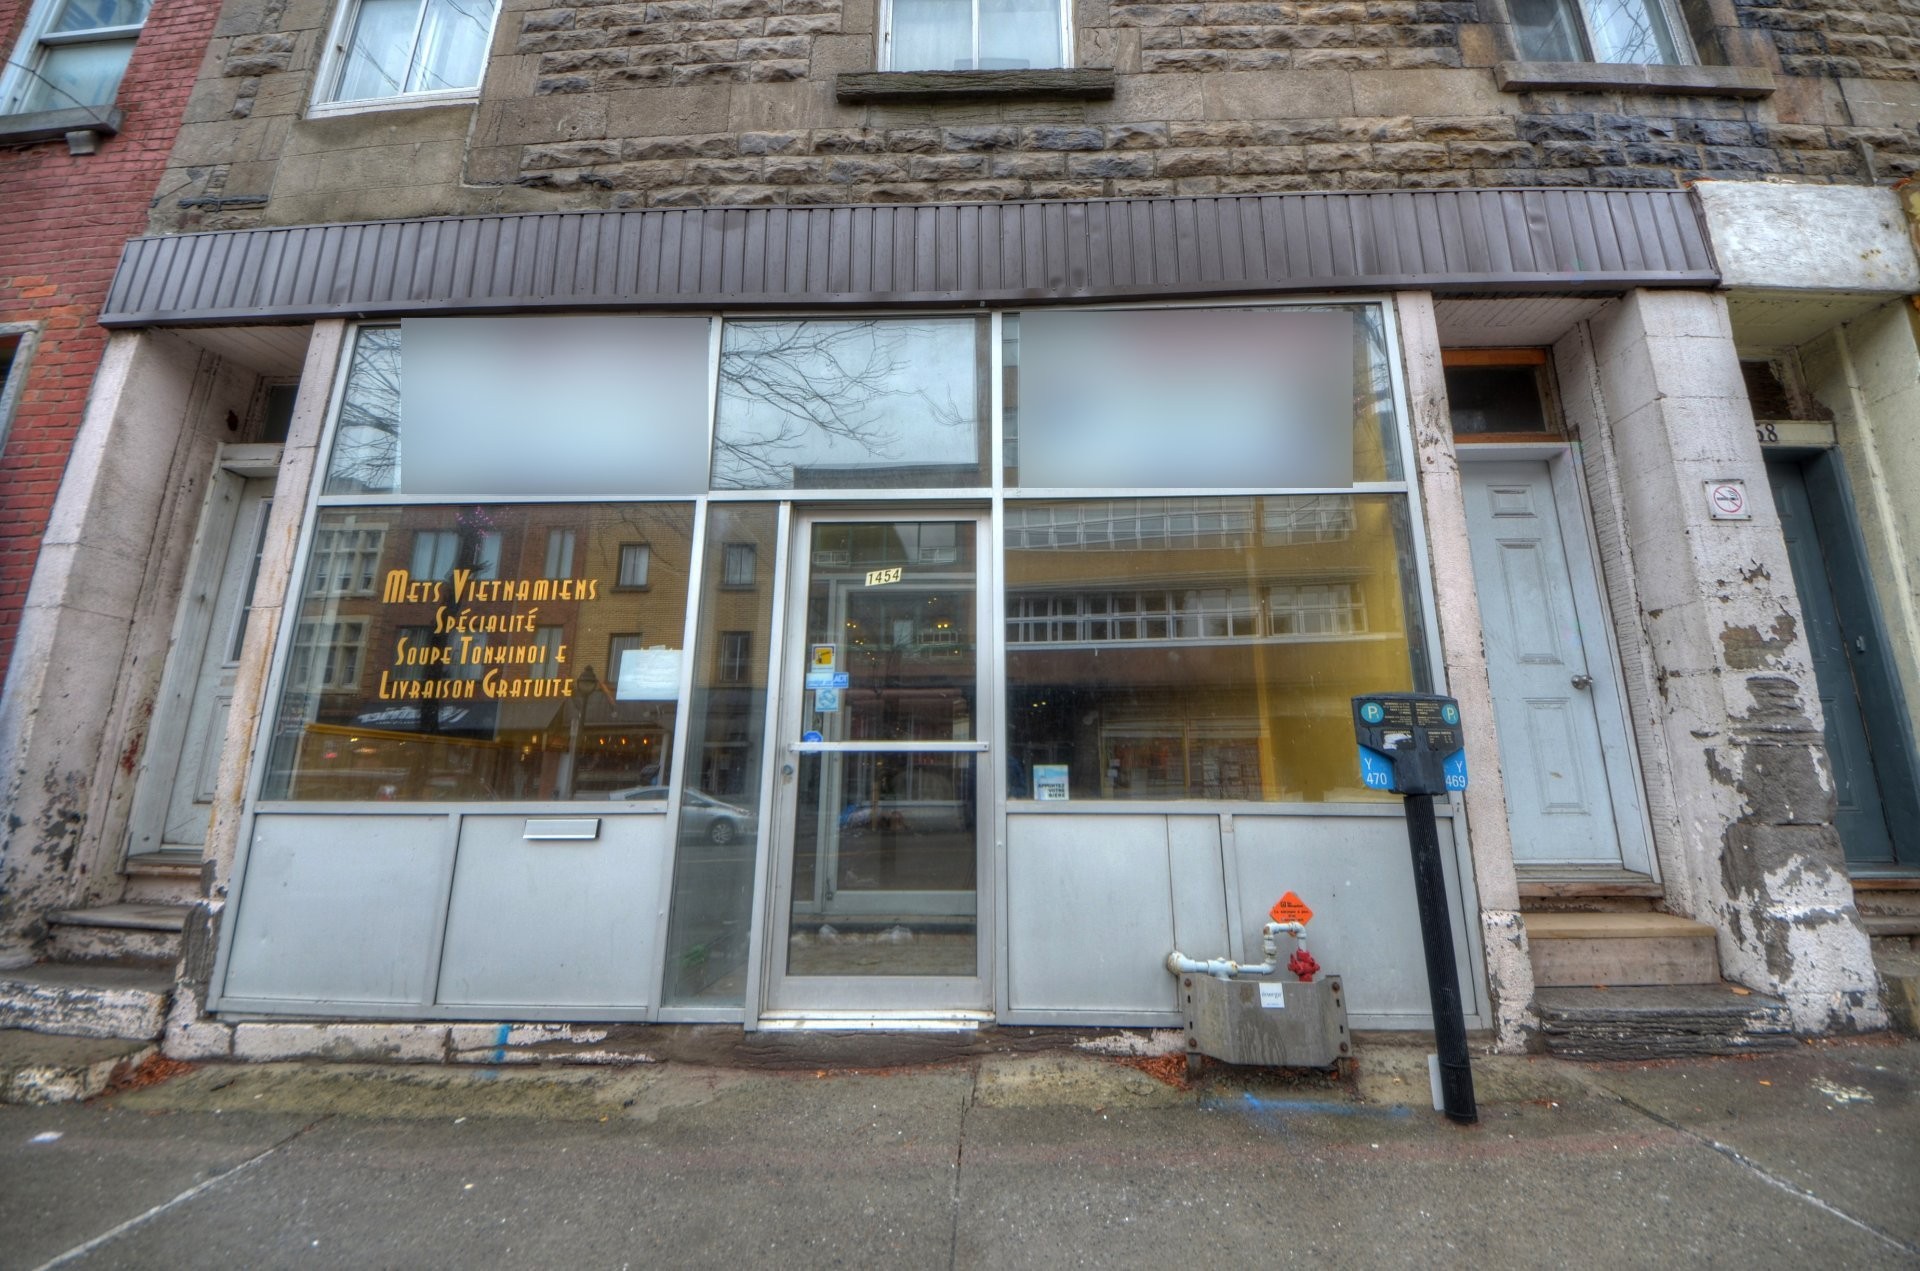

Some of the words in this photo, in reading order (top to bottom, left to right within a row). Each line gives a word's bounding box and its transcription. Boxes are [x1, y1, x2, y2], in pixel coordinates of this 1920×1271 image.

[382, 569, 442, 603] METS
[453, 569, 599, 603] VIETNAMIENS
[868, 568, 900, 586] 1454
[434, 606, 539, 634] SPÉCIALITÉ
[395, 637, 452, 666] SOUPE
[379, 670, 476, 699] LIVRAISON
[482, 668, 574, 698] GRATUITE
[1364, 757, 1372, 770] Y
[1455, 760, 1463, 773] Y
[1366, 773, 1387, 785] 470
[1445, 776, 1466, 788] 469
